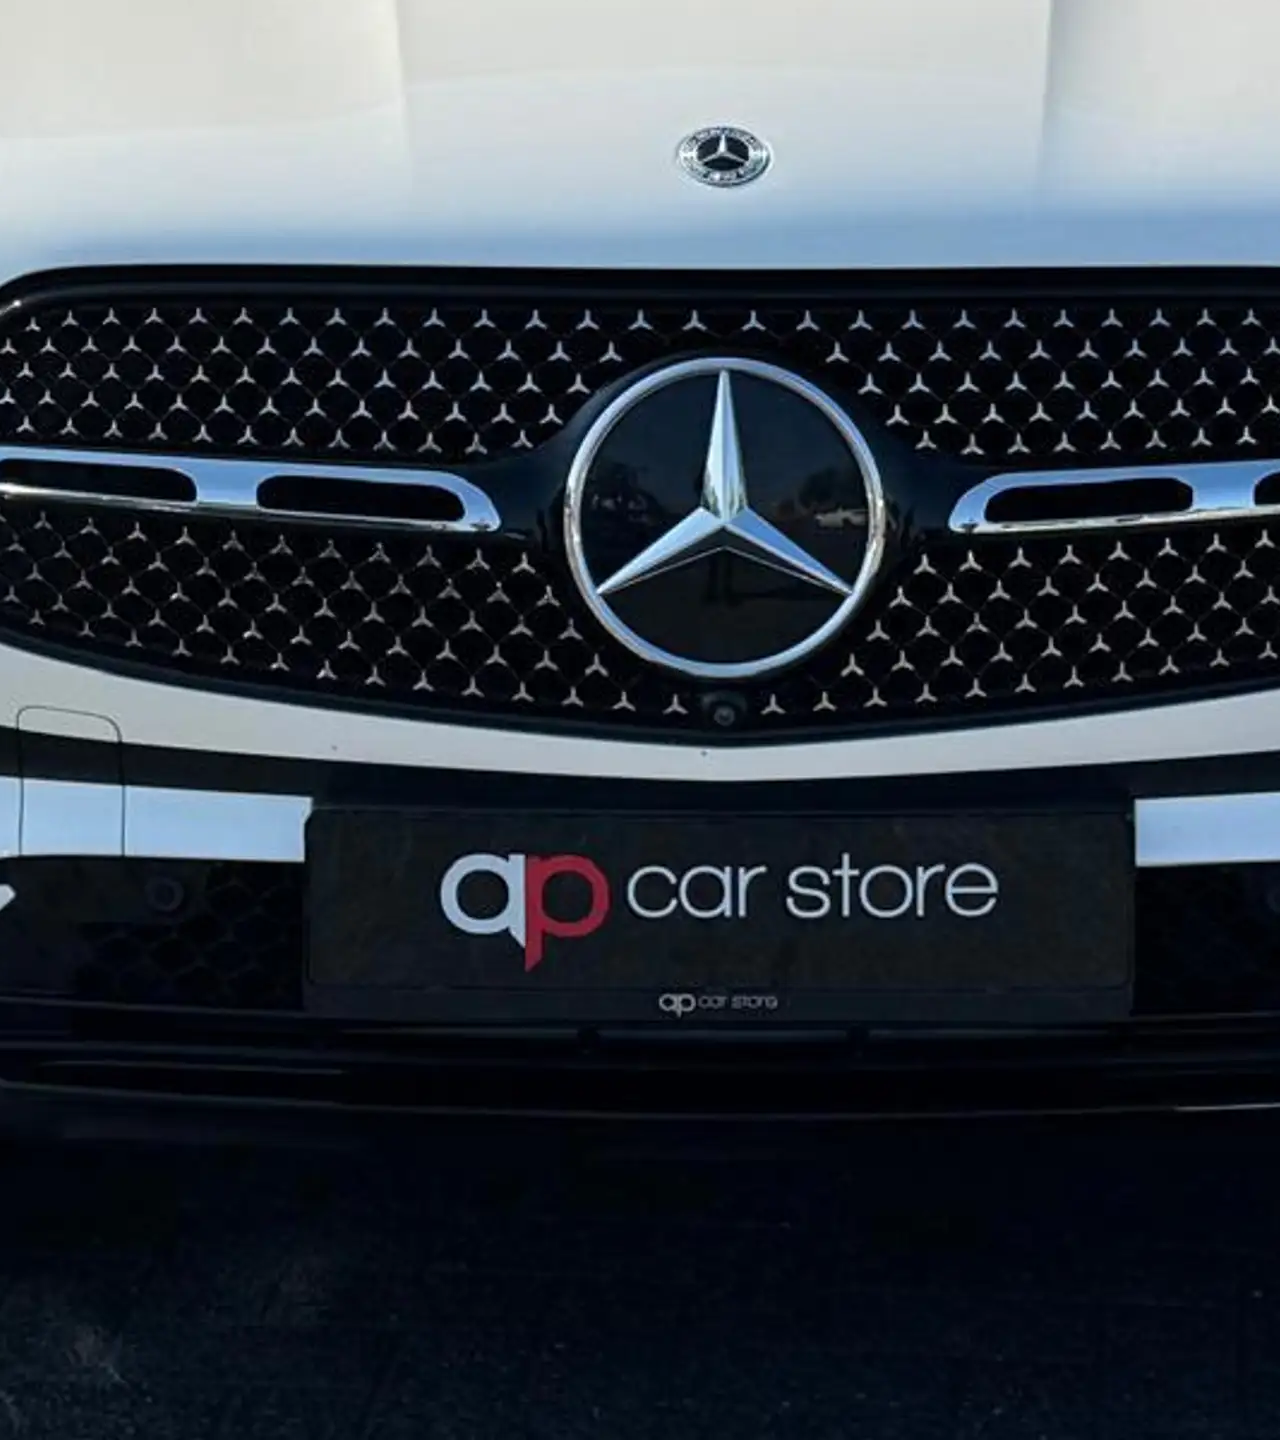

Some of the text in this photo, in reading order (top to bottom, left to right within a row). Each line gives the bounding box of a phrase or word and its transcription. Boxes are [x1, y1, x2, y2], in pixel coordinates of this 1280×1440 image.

[440, 853, 999, 971] ap car store
[659, 993, 696, 1018] ap
[699, 996, 727, 1009] car
